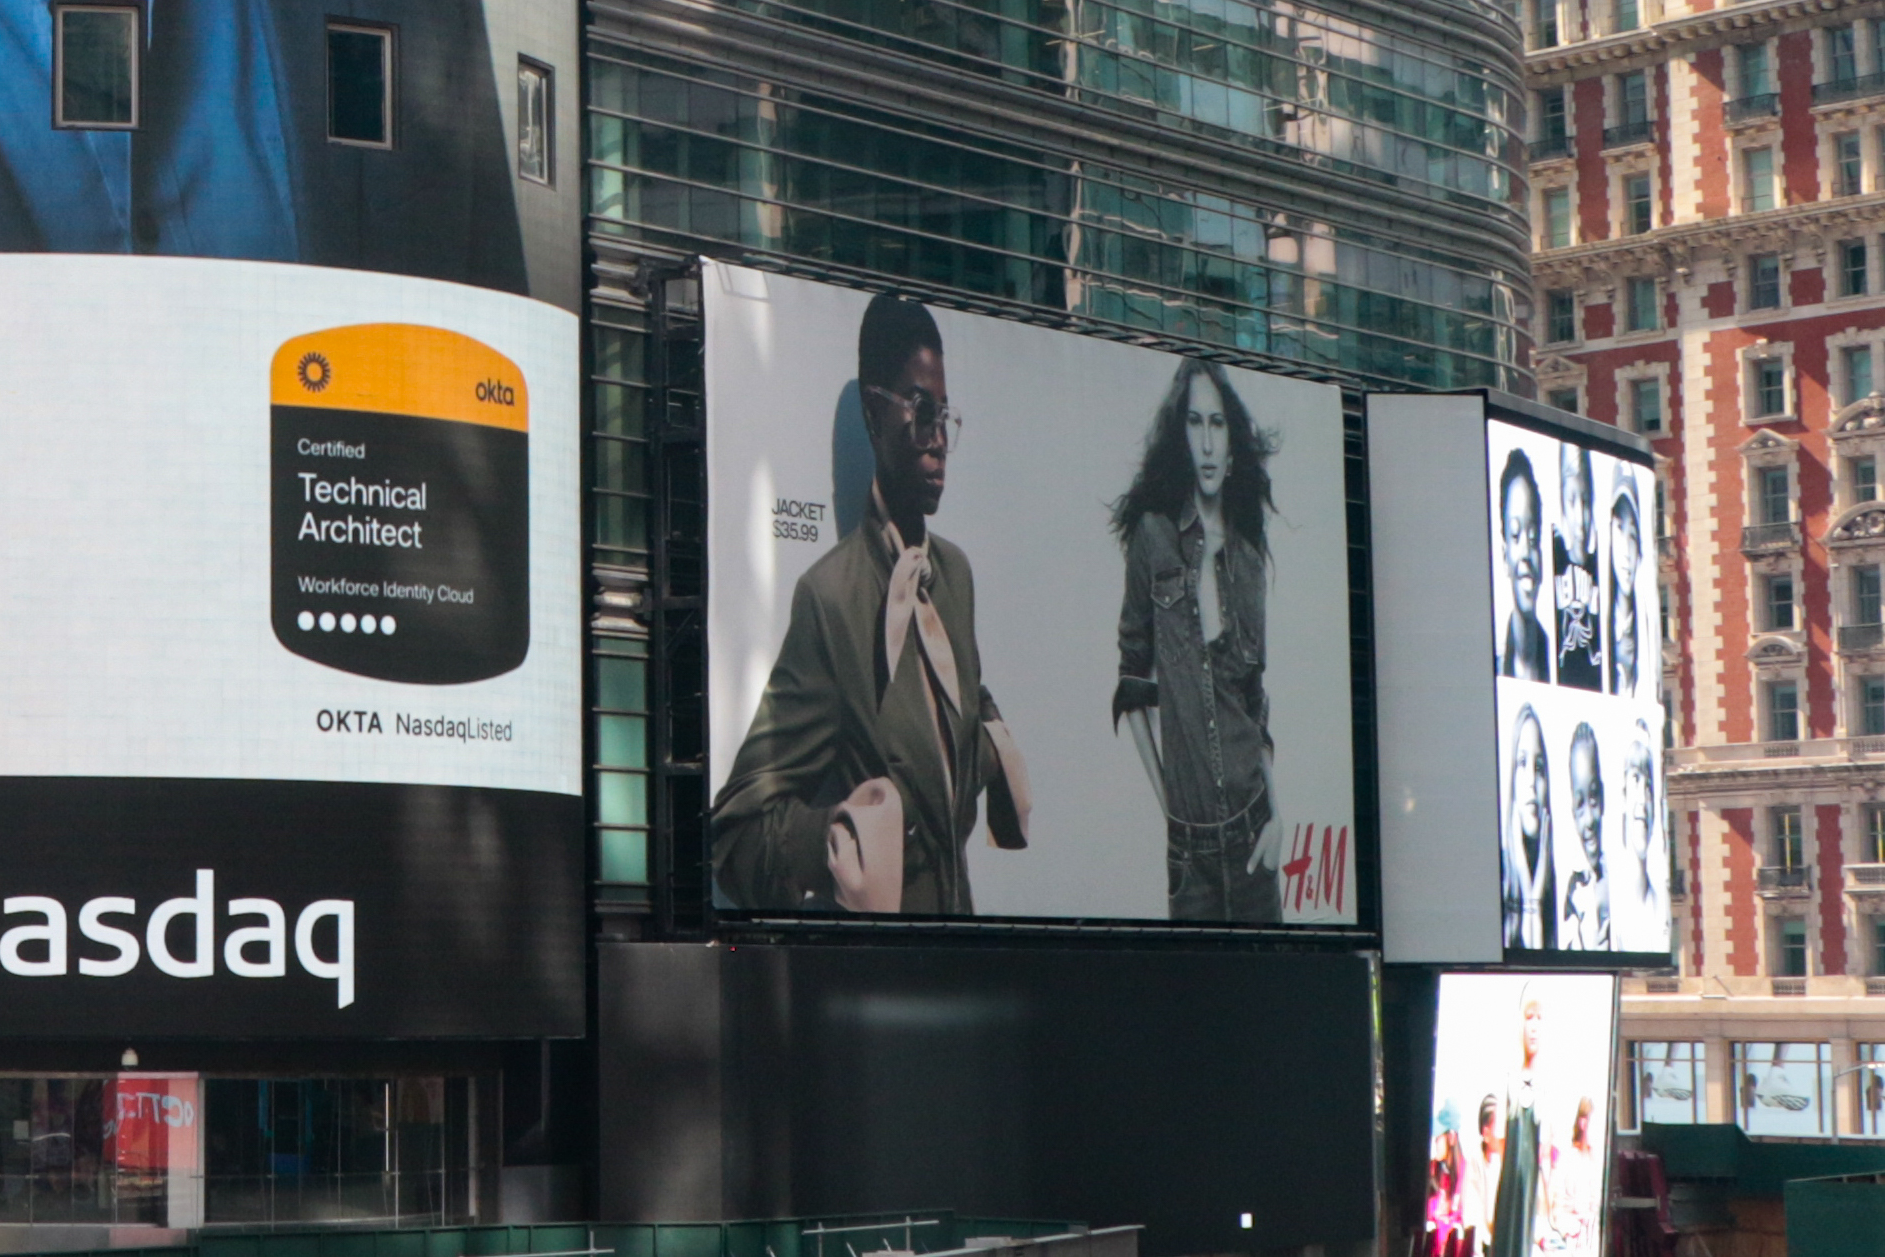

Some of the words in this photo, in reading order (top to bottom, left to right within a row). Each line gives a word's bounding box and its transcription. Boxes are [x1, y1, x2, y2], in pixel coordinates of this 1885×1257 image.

[475, 378, 515, 407] okta
[297, 438, 366, 460] Certified
[298, 472, 427, 511] Technical
[772, 498, 826, 521] JACKET
[298, 512, 422, 548] Architect
[773, 519, 818, 542] $35.99
[297, 576, 379, 597] Workforce
[383, 580, 434, 604] Identity
[437, 585, 474, 604] Cloud
[317, 709, 383, 734] OKTA
[1282, 822, 1348, 915] H&M
